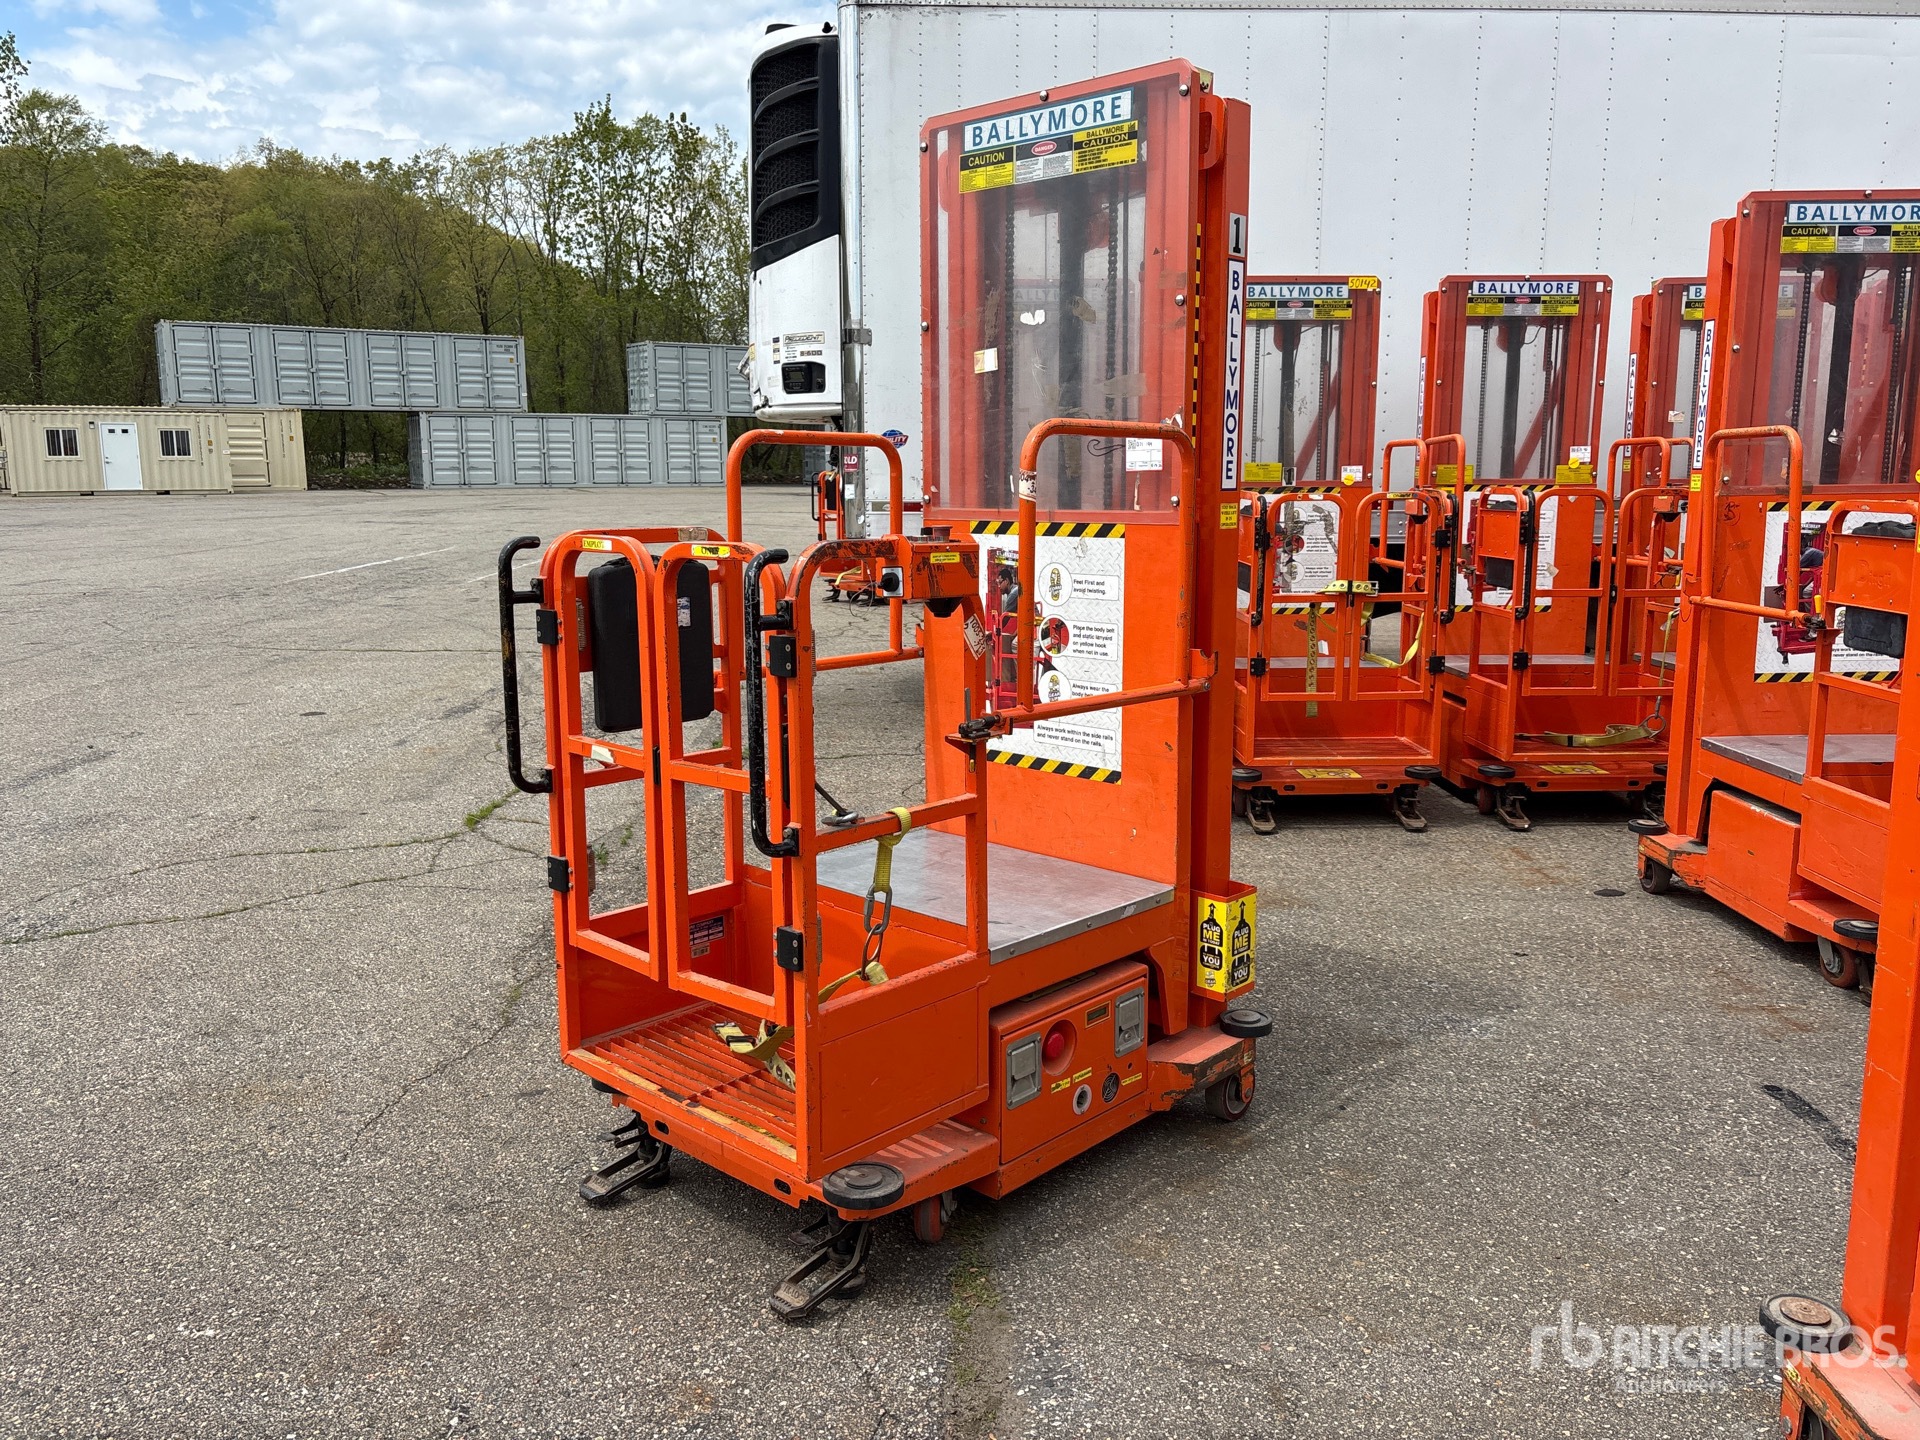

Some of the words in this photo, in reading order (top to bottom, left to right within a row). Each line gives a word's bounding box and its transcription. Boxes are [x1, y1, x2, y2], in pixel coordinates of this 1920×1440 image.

[972, 96, 1123, 147] BALLYMORE
[1086, 126, 1124, 138] BALLYMORE
[1082, 134, 1128, 148] CAUTION
[968, 152, 1004, 166] CAUTION
[1232, 218, 1242, 254] 1
[1350, 279, 1376, 288] 50142
[1478, 282, 1574, 294] BALLYMORE
[1248, 286, 1344, 298] BALLYMORE
[1225, 270, 1240, 480] BALLYMORE
[1696, 329, 1712, 463] BALLYMORE
[1203, 923, 1220, 932] PLUG
[1234, 927, 1249, 938] PLUG
[1203, 929, 1220, 941] ME
[1234, 934, 1248, 949] ME
[1203, 955, 1220, 965] YOU
[1234, 967, 1248, 980] YOU
